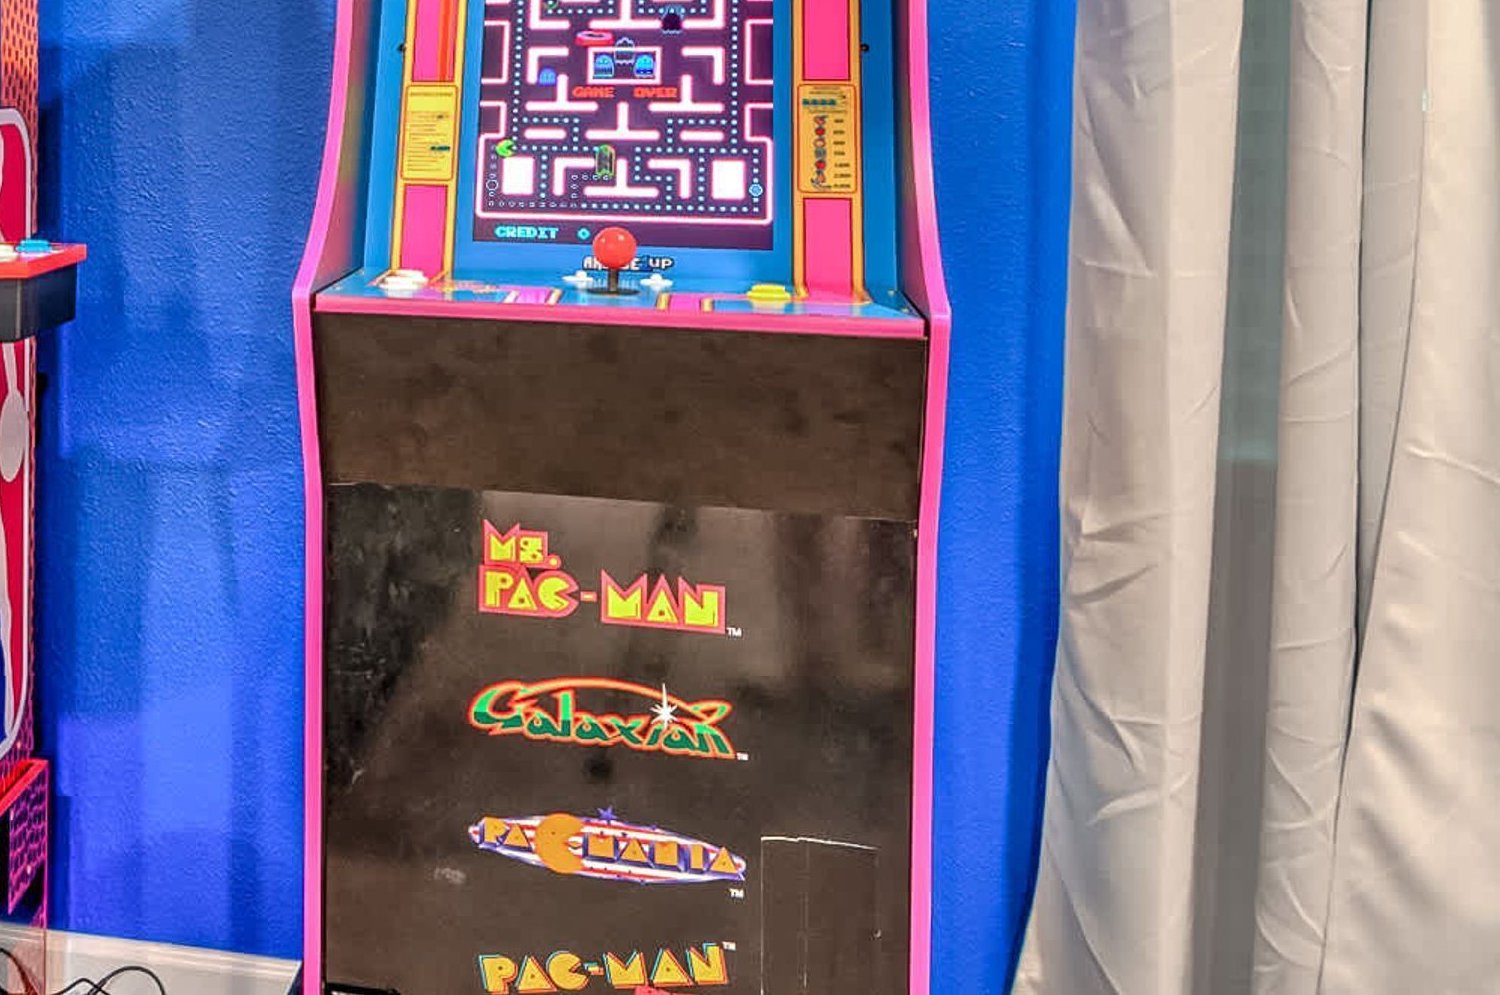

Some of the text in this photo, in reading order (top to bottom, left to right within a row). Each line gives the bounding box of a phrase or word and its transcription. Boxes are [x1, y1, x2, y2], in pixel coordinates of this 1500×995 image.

[572, 86, 678, 98] GAME OVER
[494, 225, 559, 240] CREDIT
[480, 567, 725, 633] PAC-MAN
[469, 678, 735, 759] Galaxian
[479, 942, 728, 994] PAC-MAN
